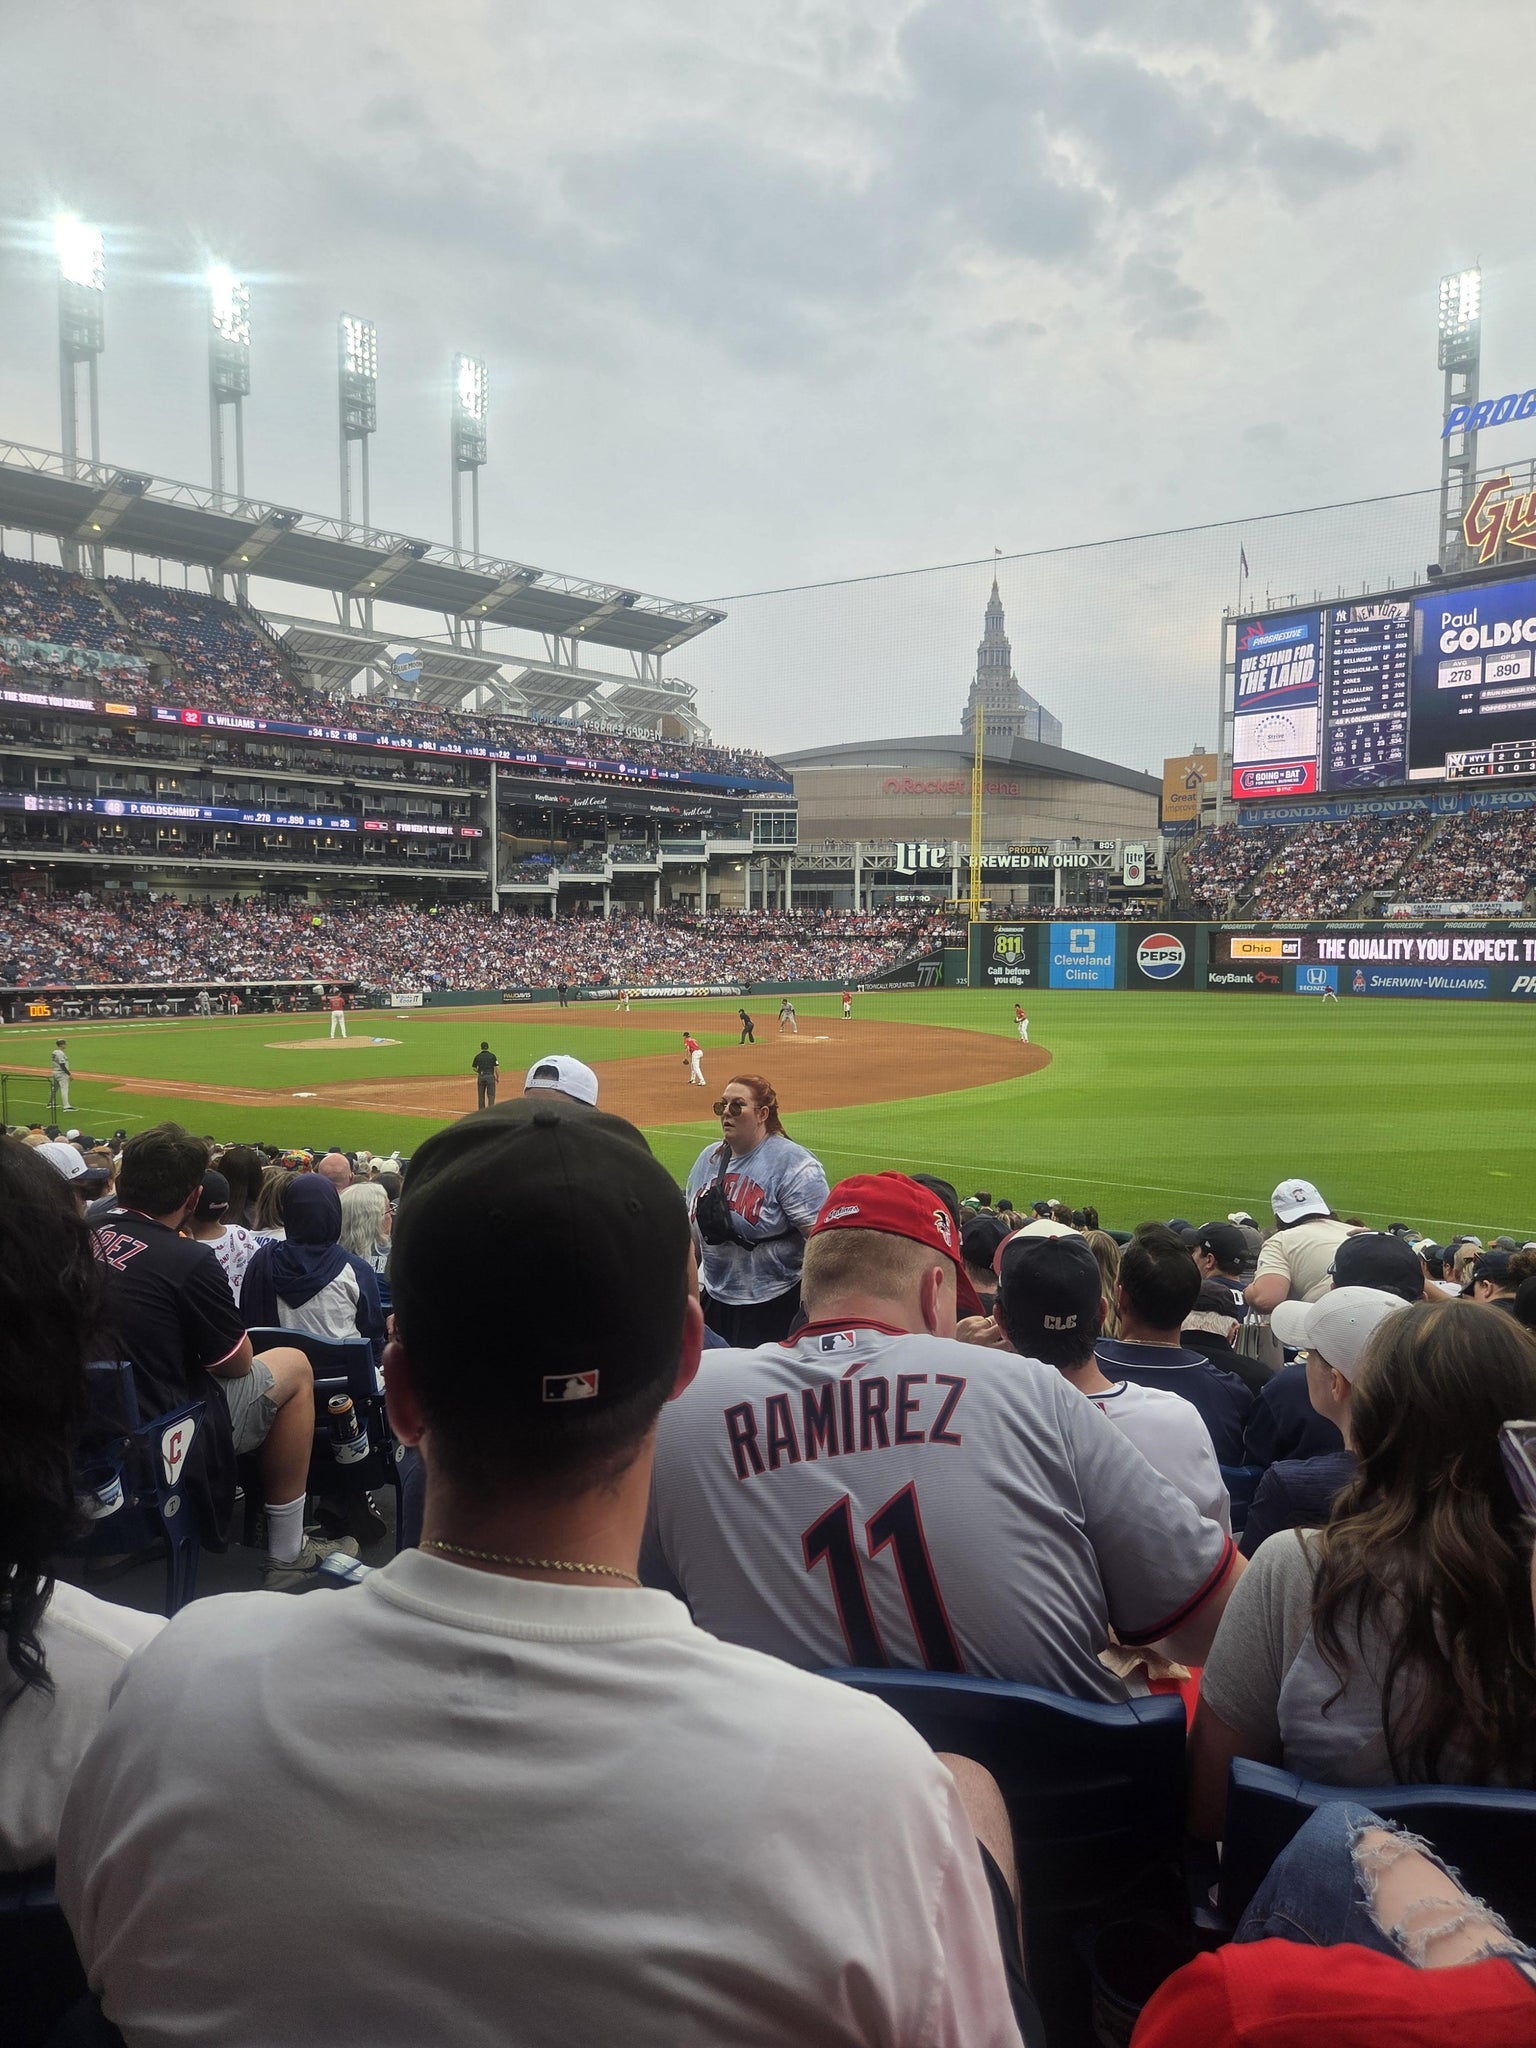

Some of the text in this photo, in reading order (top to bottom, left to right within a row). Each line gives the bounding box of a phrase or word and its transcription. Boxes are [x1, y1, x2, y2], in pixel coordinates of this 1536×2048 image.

[1441, 607, 1477, 630] Paul
[1241, 643, 1314, 673] WE STAND FOR
[1239, 658, 1315, 696] THE LAND
[1448, 669, 1471, 683] .278
[1493, 663, 1520, 678] .890
[185, 712, 198, 723] 32
[207, 715, 216, 725] G.
[217, 715, 256, 730] WILLIAMS
[312, 728, 340, 739] 34 52
[381, 736, 413, 748] 14 9-3
[1469, 750, 1534, 763] NYY 2 0 1
[1255, 769, 1301, 781] GOING BAT
[1469, 766, 1485, 775] CLE
[1498, 765, 1504, 773] 0
[902, 777, 964, 795] Rocket
[1490, 791, 1536, 807] HON
[131, 804, 139, 813] P.
[140, 804, 199, 819] GOLDSCHMIDT
[1262, 806, 1331, 820] HONDA
[1353, 799, 1430, 815] HONDA
[1009, 846, 1048, 855] PROUDLY
[1099, 841, 1115, 850] 8:05
[894, 842, 946, 876] Lite
[1033, 855, 1049, 868] IN
[1053, 855, 1089, 868] OHIO
[1126, 852, 1143, 865] Lite
[1326, 922, 1366, 930] PROGRESSIVE
[1383, 922, 1425, 930] PROGRESSIVE
[1443, 922, 1488, 930] PROGRESSIVE
[997, 935, 1021, 954] 811
[1242, 943, 1298, 954] Ohio CAT
[1317, 939, 1536, 961] THE QUALITY YOU EXPECT. T
[1054, 955, 1112, 967] Cleveland
[1140, 951, 1182, 962] PEPSI
[988, 966, 1030, 976] Call before
[1065, 969, 1099, 981] Clinic
[955, 977, 967, 986] 325
[994, 975, 1024, 986] you dig.
[1208, 972, 1254, 985] KeyBank
[641, 987, 695, 997] CONRAD'S
[1299, 984, 1327, 992] HOND
[30, 1005, 51, 1017] 005
[824, 1205, 860, 1223] Indians
[1044, 1314, 1077, 1331] CLE
[723, 1362, 967, 1482] RAMÍREZ
[169, 1430, 182, 1464] C
[169, 1500, 176, 1512] T
[801, 1480, 968, 1676] 11
